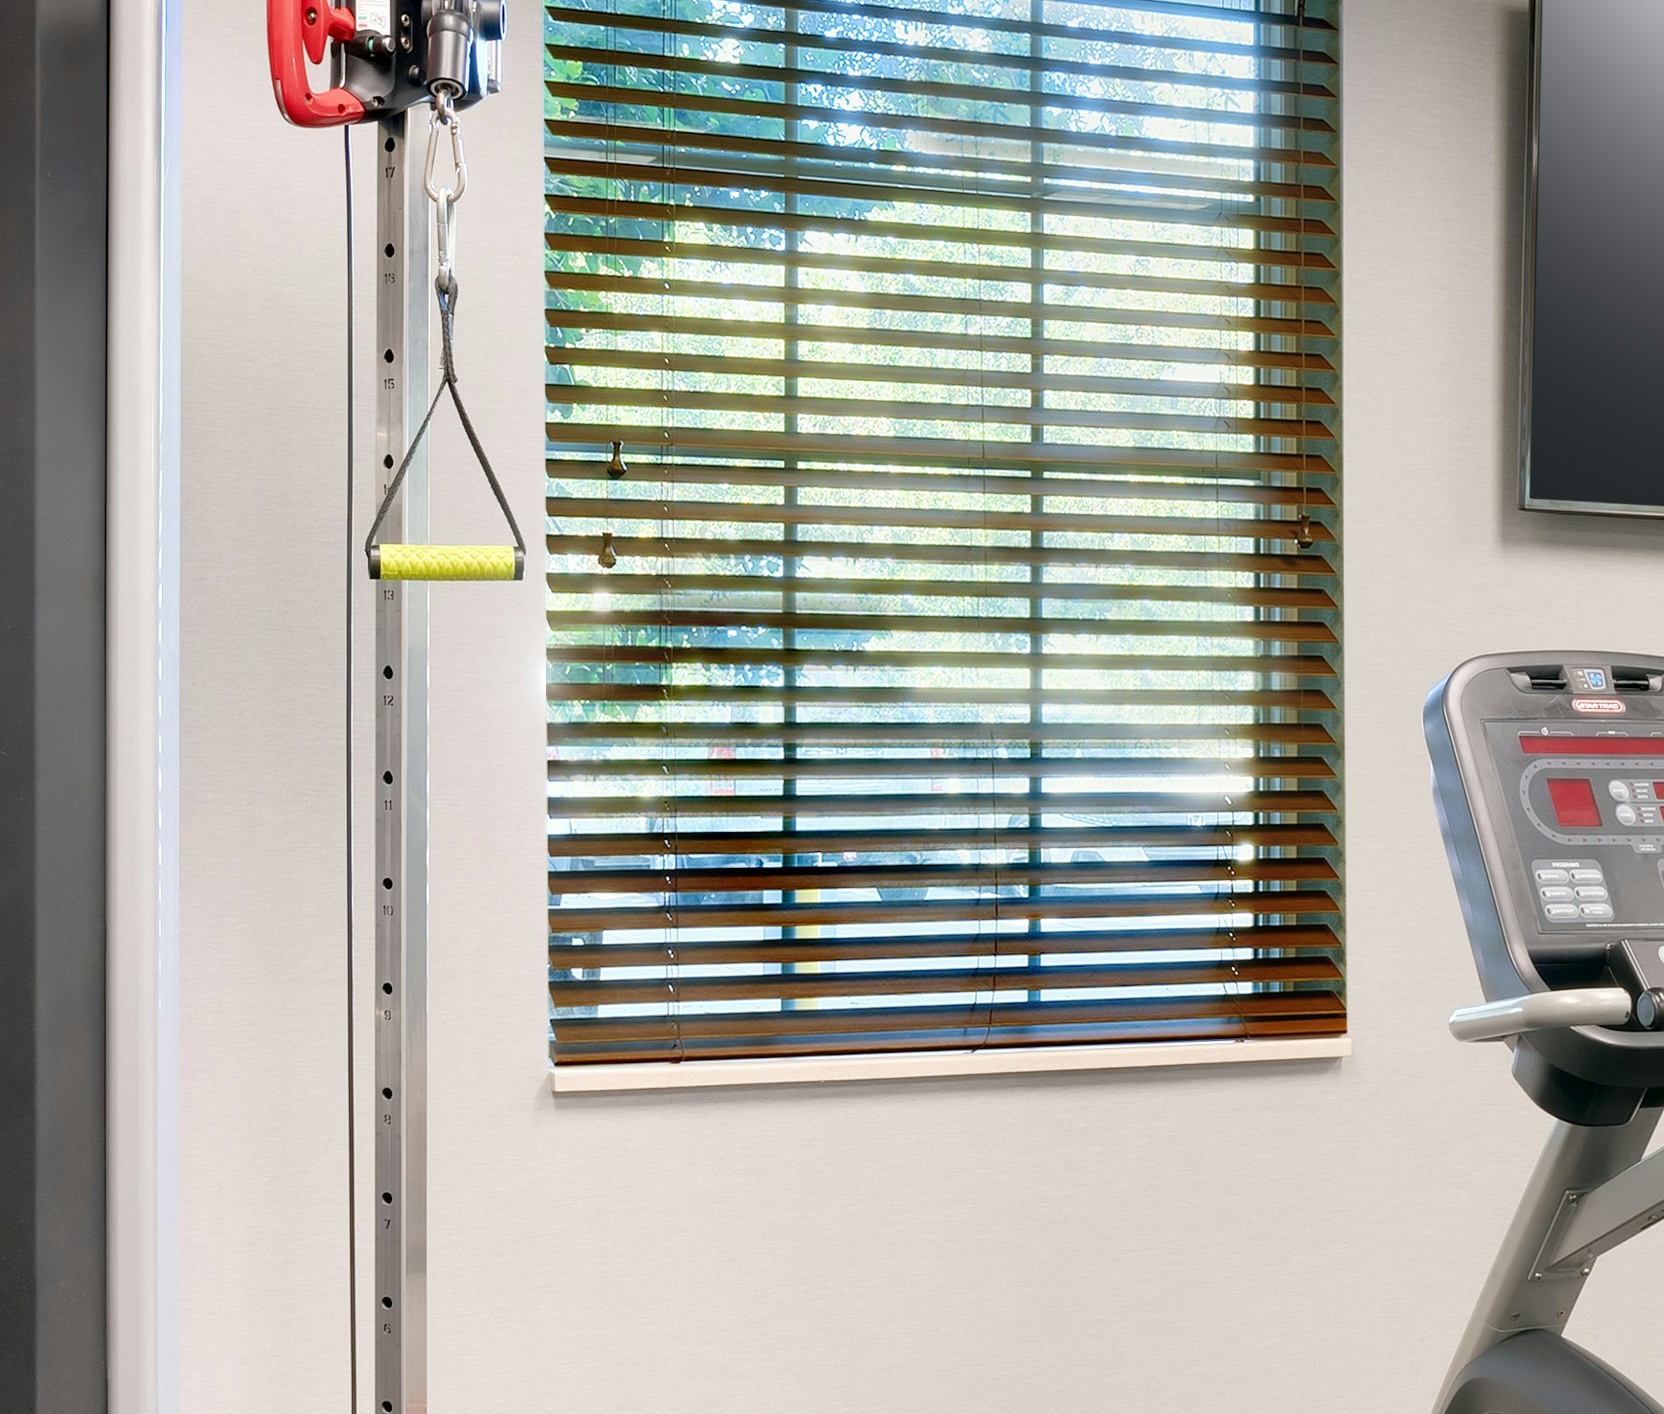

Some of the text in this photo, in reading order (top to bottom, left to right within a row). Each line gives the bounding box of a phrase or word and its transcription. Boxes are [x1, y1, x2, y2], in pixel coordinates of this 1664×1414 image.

[385, 167, 395, 178] 17
[384, 273, 396, 284] 16
[384, 378, 395, 389] 15
[384, 590, 394, 600] 13
[383, 695, 394, 706] 12
[384, 800, 392, 810] 11
[383, 905, 394, 916] 10
[384, 1010, 391, 1021] 9
[384, 1115, 391, 1125] 8
[384, 1219, 391, 1229] 7
[384, 1324, 391, 1334] 6
